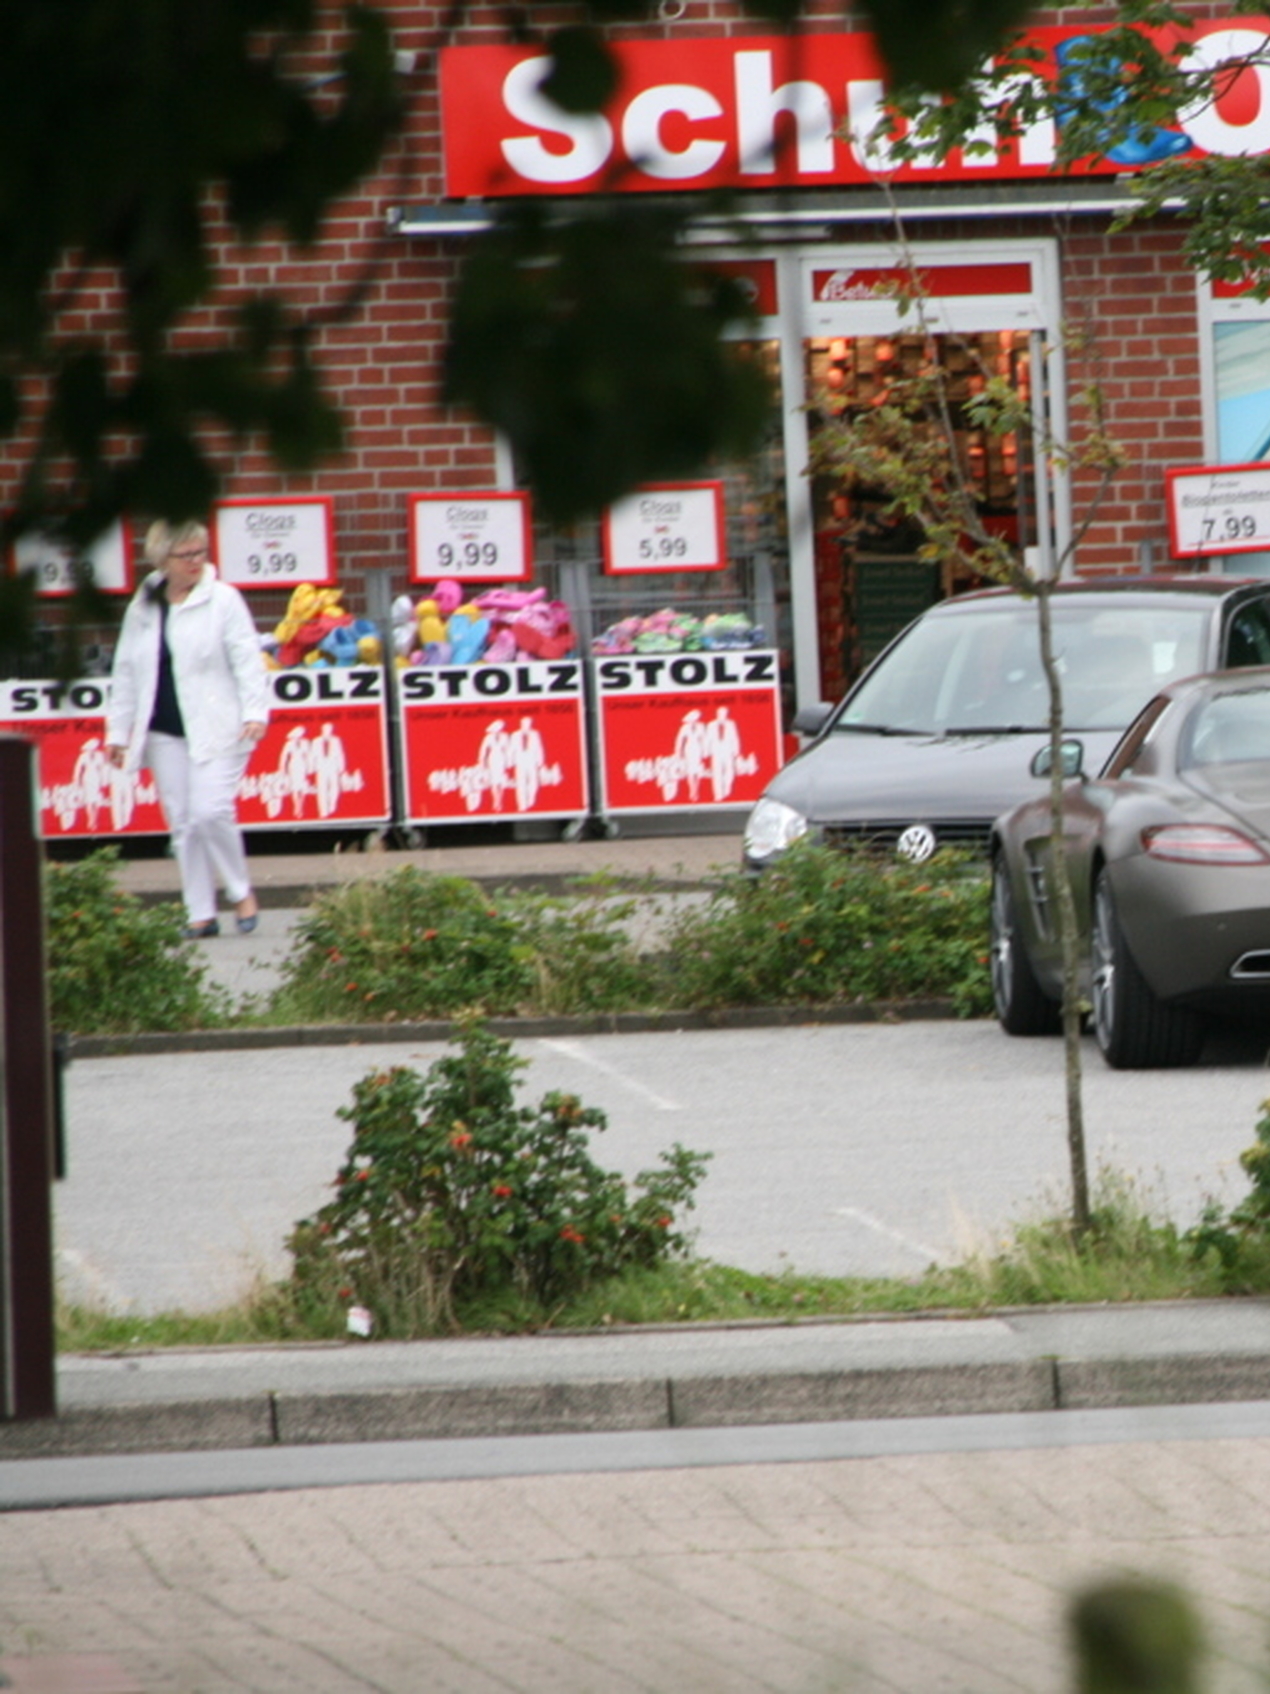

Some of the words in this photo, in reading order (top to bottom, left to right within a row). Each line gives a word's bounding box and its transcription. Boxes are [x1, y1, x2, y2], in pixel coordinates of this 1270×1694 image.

[1202, 515, 1256, 542] 7,99
[438, 543, 498, 571] 9,99
[639, 538, 687, 561] 5,99
[247, 553, 298, 576] 9,99
[402, 665, 579, 699] STOLZ
[599, 655, 775, 689] STOLZ
[10, 685, 113, 712] STO
[273, 670, 381, 702] OLZ
